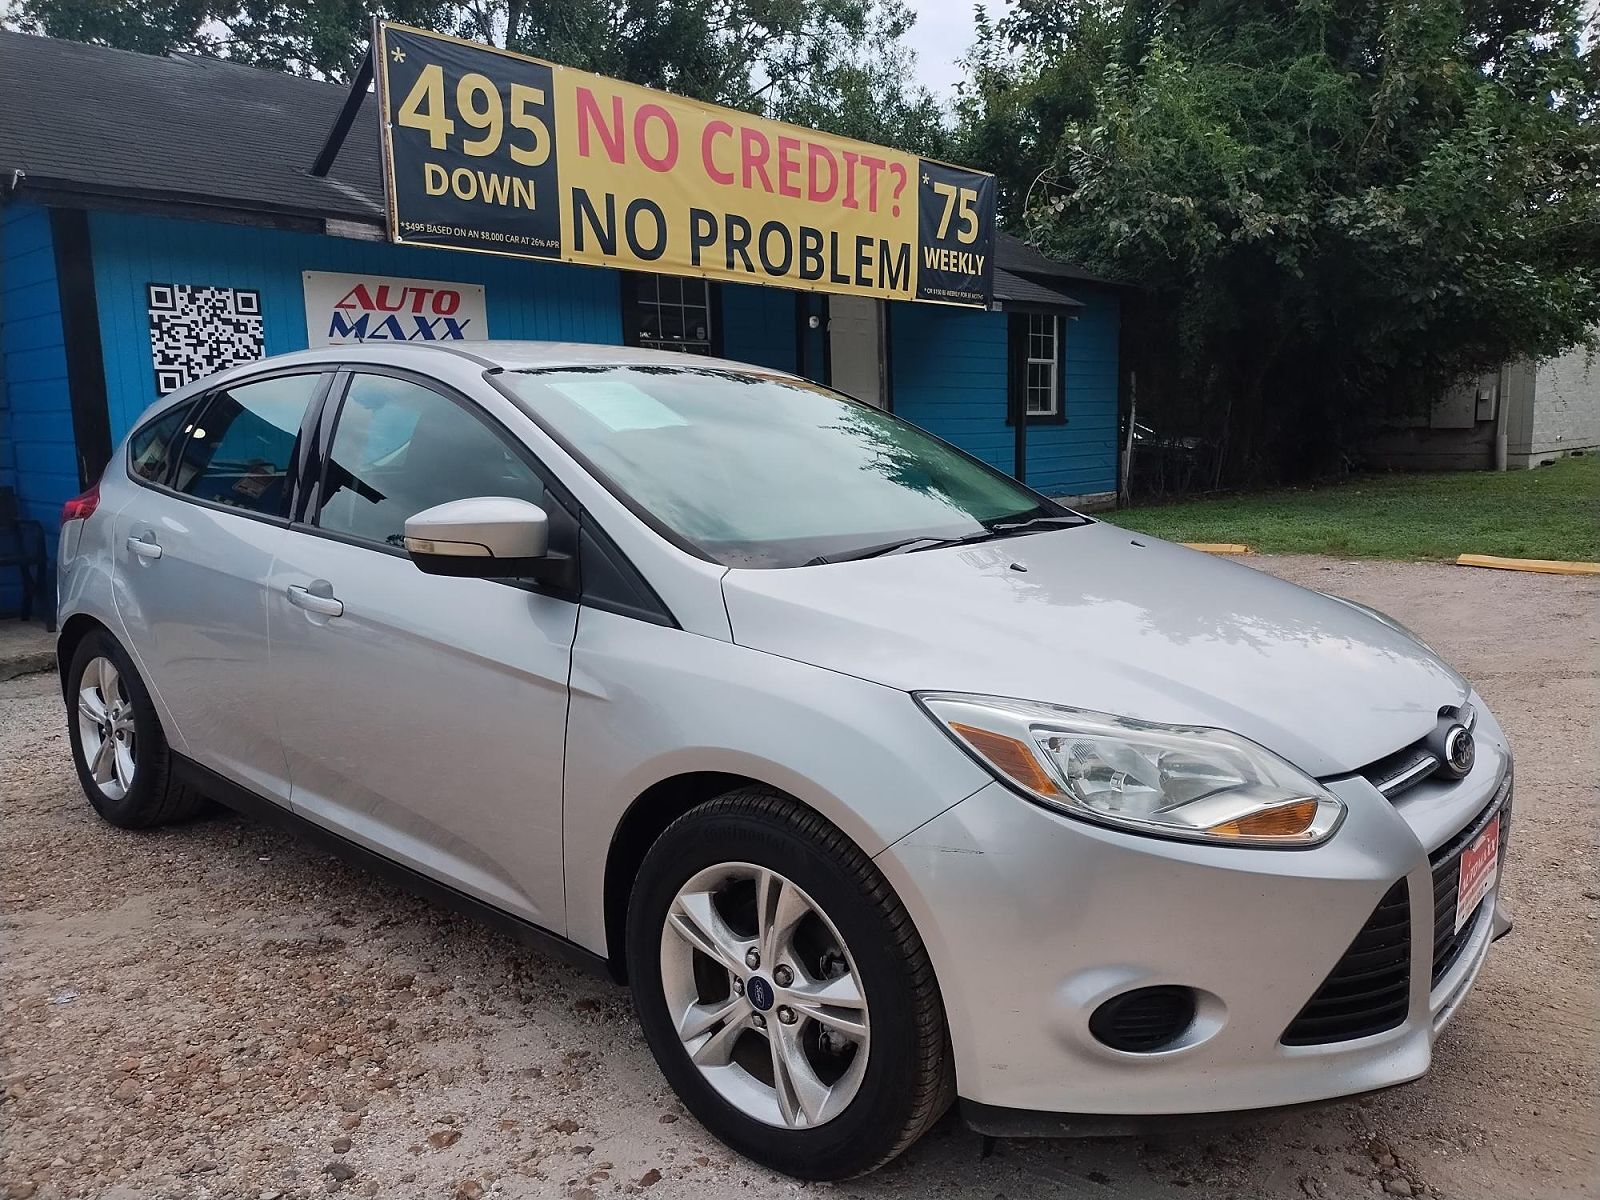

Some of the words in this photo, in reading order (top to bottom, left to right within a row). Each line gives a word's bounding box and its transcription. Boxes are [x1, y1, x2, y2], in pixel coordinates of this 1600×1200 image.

[575, 86, 679, 173] NO
[702, 120, 907, 218] CREDIT?
[424, 163, 536, 210] DOWN
[426, 224, 452, 235] BASED
[454, 227, 467, 237] ON
[468, 229, 480, 239] AN
[481, 231, 504, 242] $8,000
[505, 234, 520, 244] CAR
[520, 237, 531, 245] AT
[531, 238, 545, 247] 26%
[546, 240, 560, 249] APR
[571, 186, 668, 261] NO
[689, 207, 912, 292] PROBLEM
[924, 246, 985, 276] WEEKLY
[334, 283, 461, 316] AUTO
[328, 311, 471, 341] MAXX
